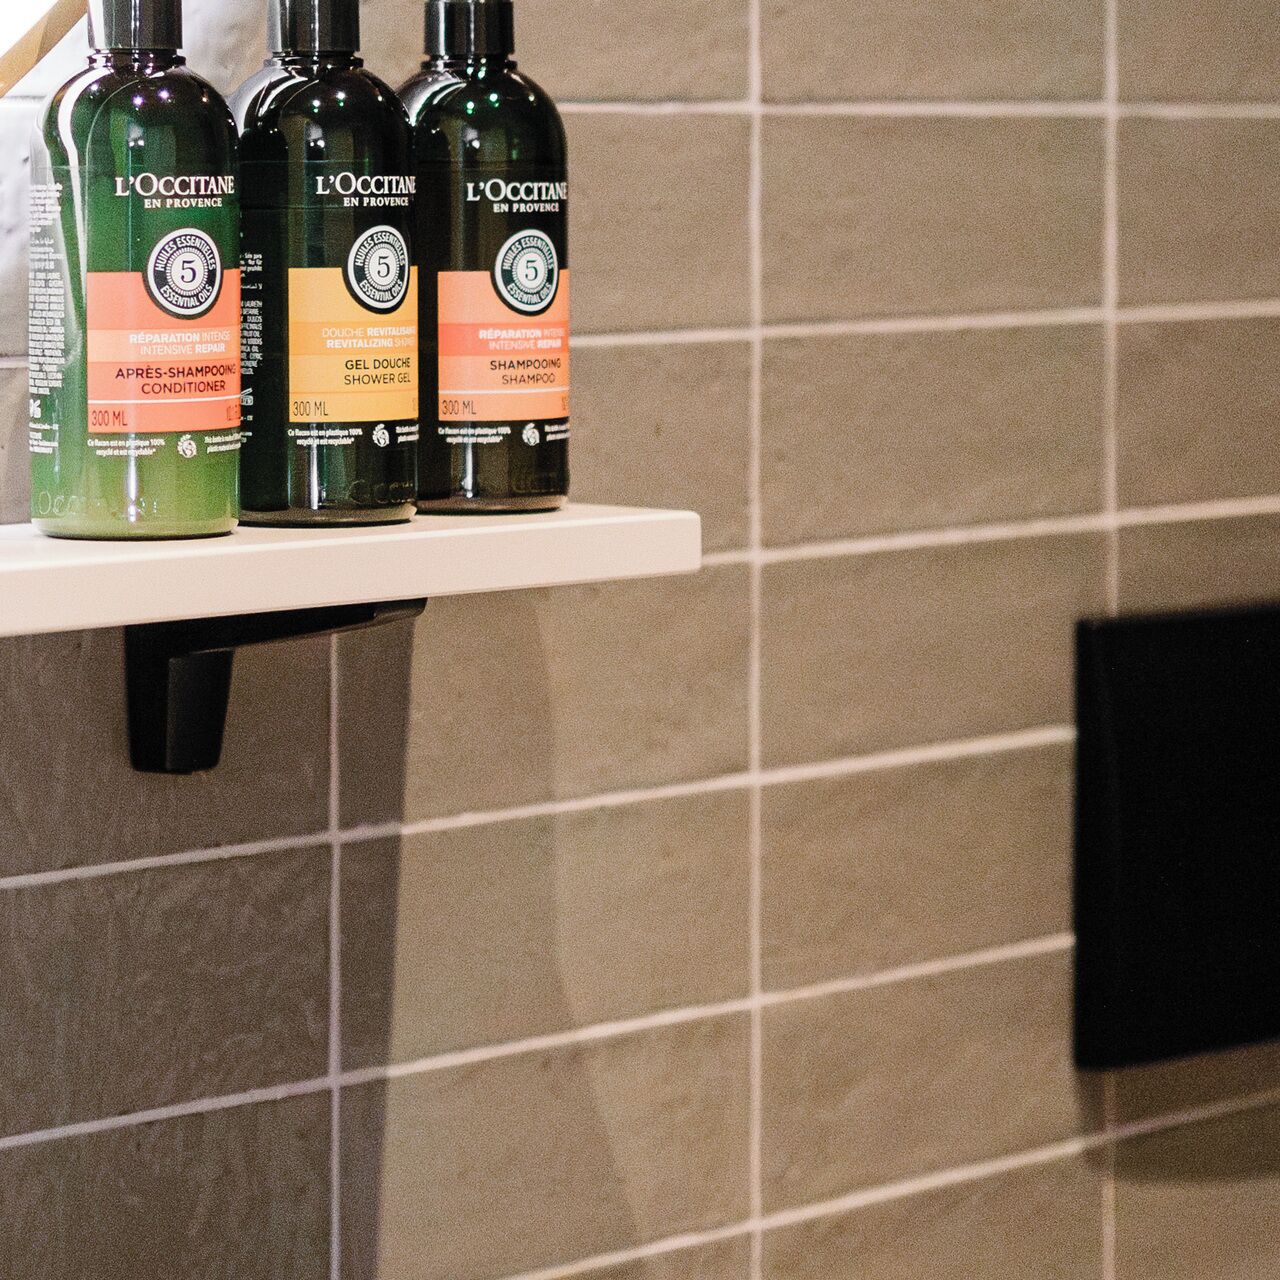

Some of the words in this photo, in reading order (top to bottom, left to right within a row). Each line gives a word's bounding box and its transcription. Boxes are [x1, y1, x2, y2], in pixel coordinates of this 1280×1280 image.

[114, 173, 234, 196] L'OCCITANE
[315, 172, 416, 195] L'OCCITANE
[466, 178, 567, 201] L'OCCITANE
[144, 200, 161, 208] EN
[166, 198, 222, 208] PROVENCE
[343, 197, 359, 207] EN
[363, 197, 409, 207] PROVENCE
[493, 203, 509, 212] EN
[513, 202, 559, 212] PROVENCE
[155, 241, 178, 271] HUILES
[176, 235, 216, 271] ESSENTIELLES
[355, 237, 375, 266] HUILES
[502, 241, 523, 270] HUILES
[180, 260, 197, 283] 5
[377, 255, 390, 278] 5
[525, 259, 538, 281] 5
[160, 284, 200, 308] ESSENTIAL
[198, 283, 213, 302] OILS
[360, 279, 393, 301] ESSENTIAL
[507, 283, 541, 304] ESSENTIAL
[129, 332, 200, 344] RÉPARATION
[201, 330, 231, 342] INTENSE
[322, 327, 364, 337] DOUCHE
[479, 328, 541, 339] RÉPARATION
[140, 344, 193, 355] INTENSIVE
[195, 342, 225, 353] REPAIR
[326, 338, 393, 349] REVITALIZING
[489, 339, 536, 350] INTENSIVE
[345, 359, 370, 370] GEL
[373, 357, 411, 369] DOUCHE
[490, 358, 561, 370] SHAMPOOING
[115, 364, 236, 379] APRÈS-SHAMPOOING
[344, 374, 395, 385] SHOWER
[397, 373, 411, 383] GEL
[501, 372, 556, 385] SHAMPOO
[141, 380, 226, 394] CONDITIONER
[293, 401, 310, 416] 300
[314, 401, 329, 416] ML
[442, 400, 459, 415] 300
[462, 400, 477, 415] ML
[92, 410, 110, 426] 300
[112, 411, 128, 426] ML
